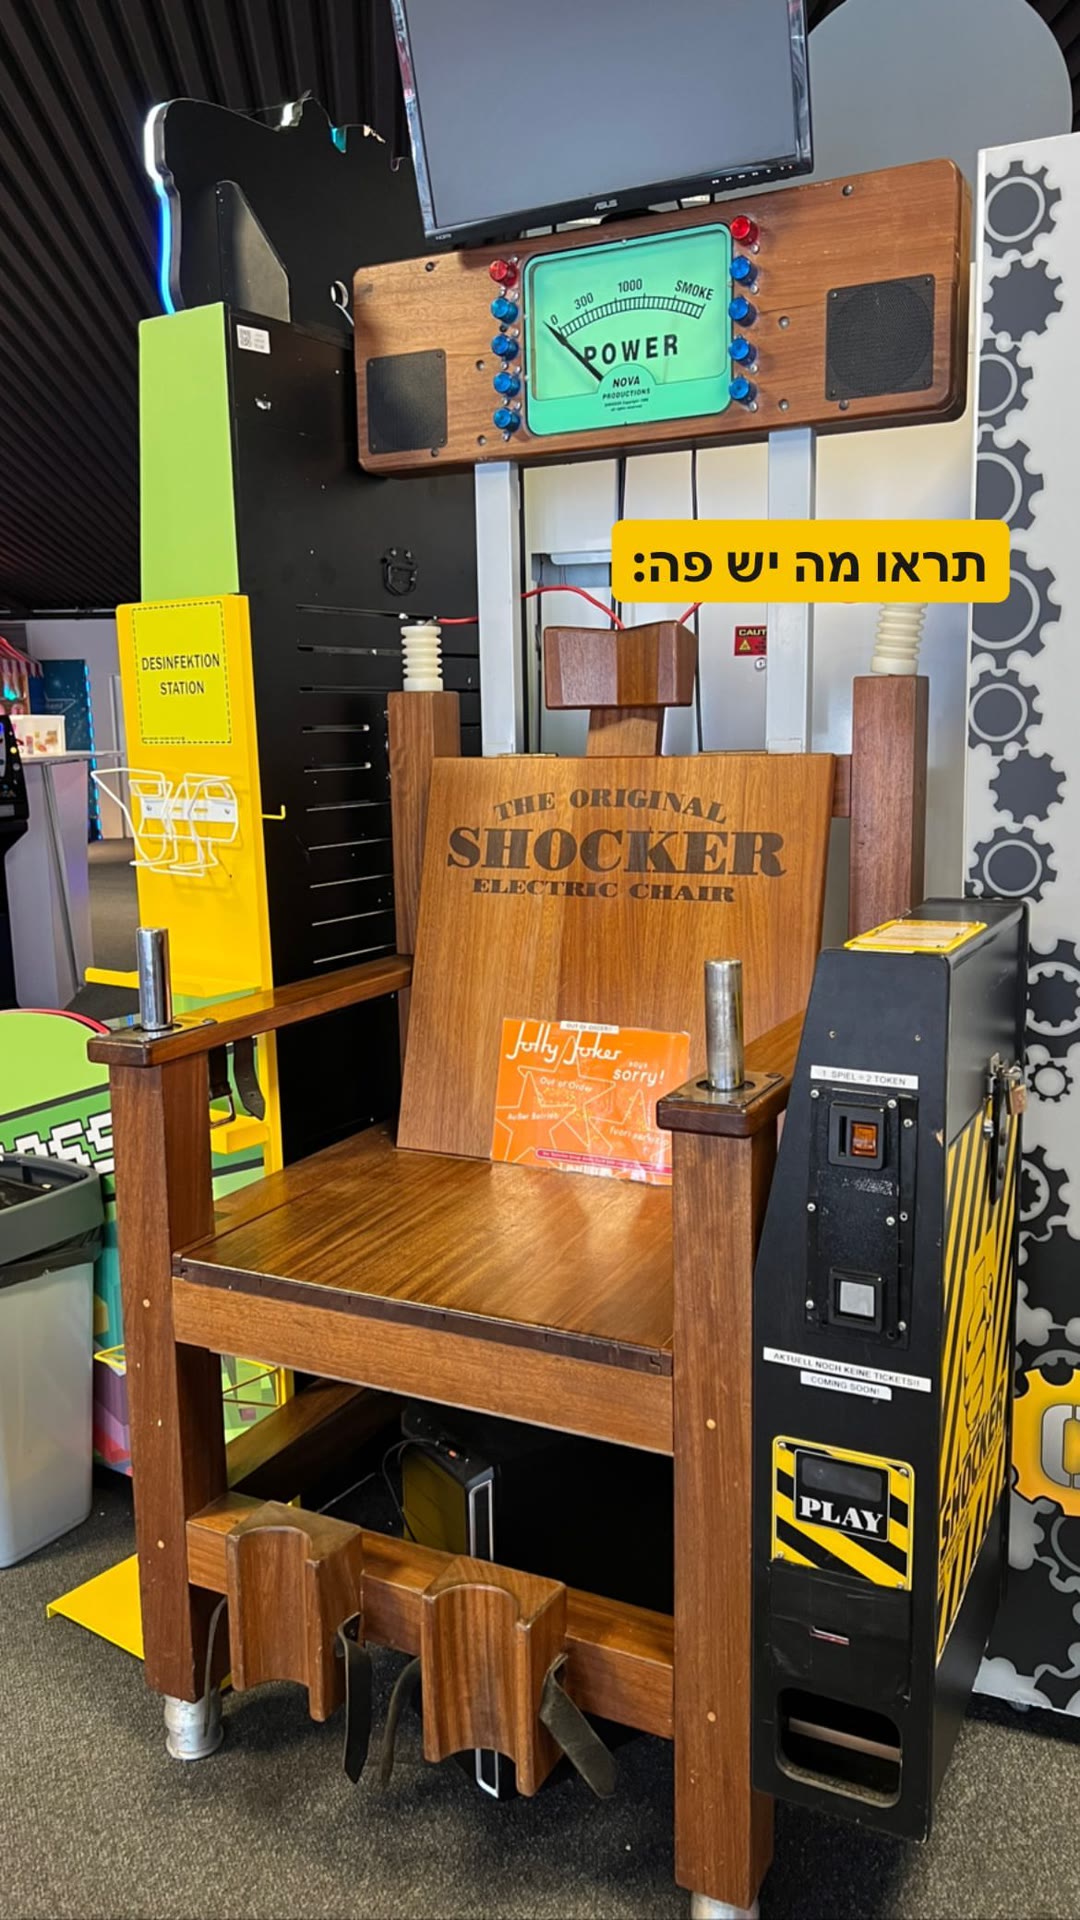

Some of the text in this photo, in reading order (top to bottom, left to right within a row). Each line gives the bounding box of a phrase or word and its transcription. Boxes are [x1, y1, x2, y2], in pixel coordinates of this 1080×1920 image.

[617, 278, 643, 293] 1000
[674, 279, 715, 301] SMOKE
[574, 292, 594, 310] 300
[550, 314, 559, 326] 0
[583, 333, 679, 365] POWER
[612, 375, 640, 388] NOVA
[602, 387, 650, 400] PRODUCTIONS
[141, 653, 221, 671] DESINFEKTION
[159, 680, 205, 695] STATION
[493, 787, 728, 825] THE ORIGINAL
[446, 825, 788, 878] SHOCKER
[472, 878, 737, 903] ELECTRIC CHAIR
[506, 1021, 622, 1065] Jolly Joker
[540, 1076, 556, 1087] Out
[568, 1081, 593, 1093] Order
[613, 1069, 665, 1087] sorry!
[832, 1071, 855, 1081] SPIEL
[865, 1074, 872, 1083] 2
[874, 1076, 906, 1086] TOKEN
[773, 1352, 920, 1387] AKTUELL NOCH KEINE TICKETS!!
[810, 1376, 880, 1395] COMING SOON!
[800, 1495, 883, 1534] PLAY
